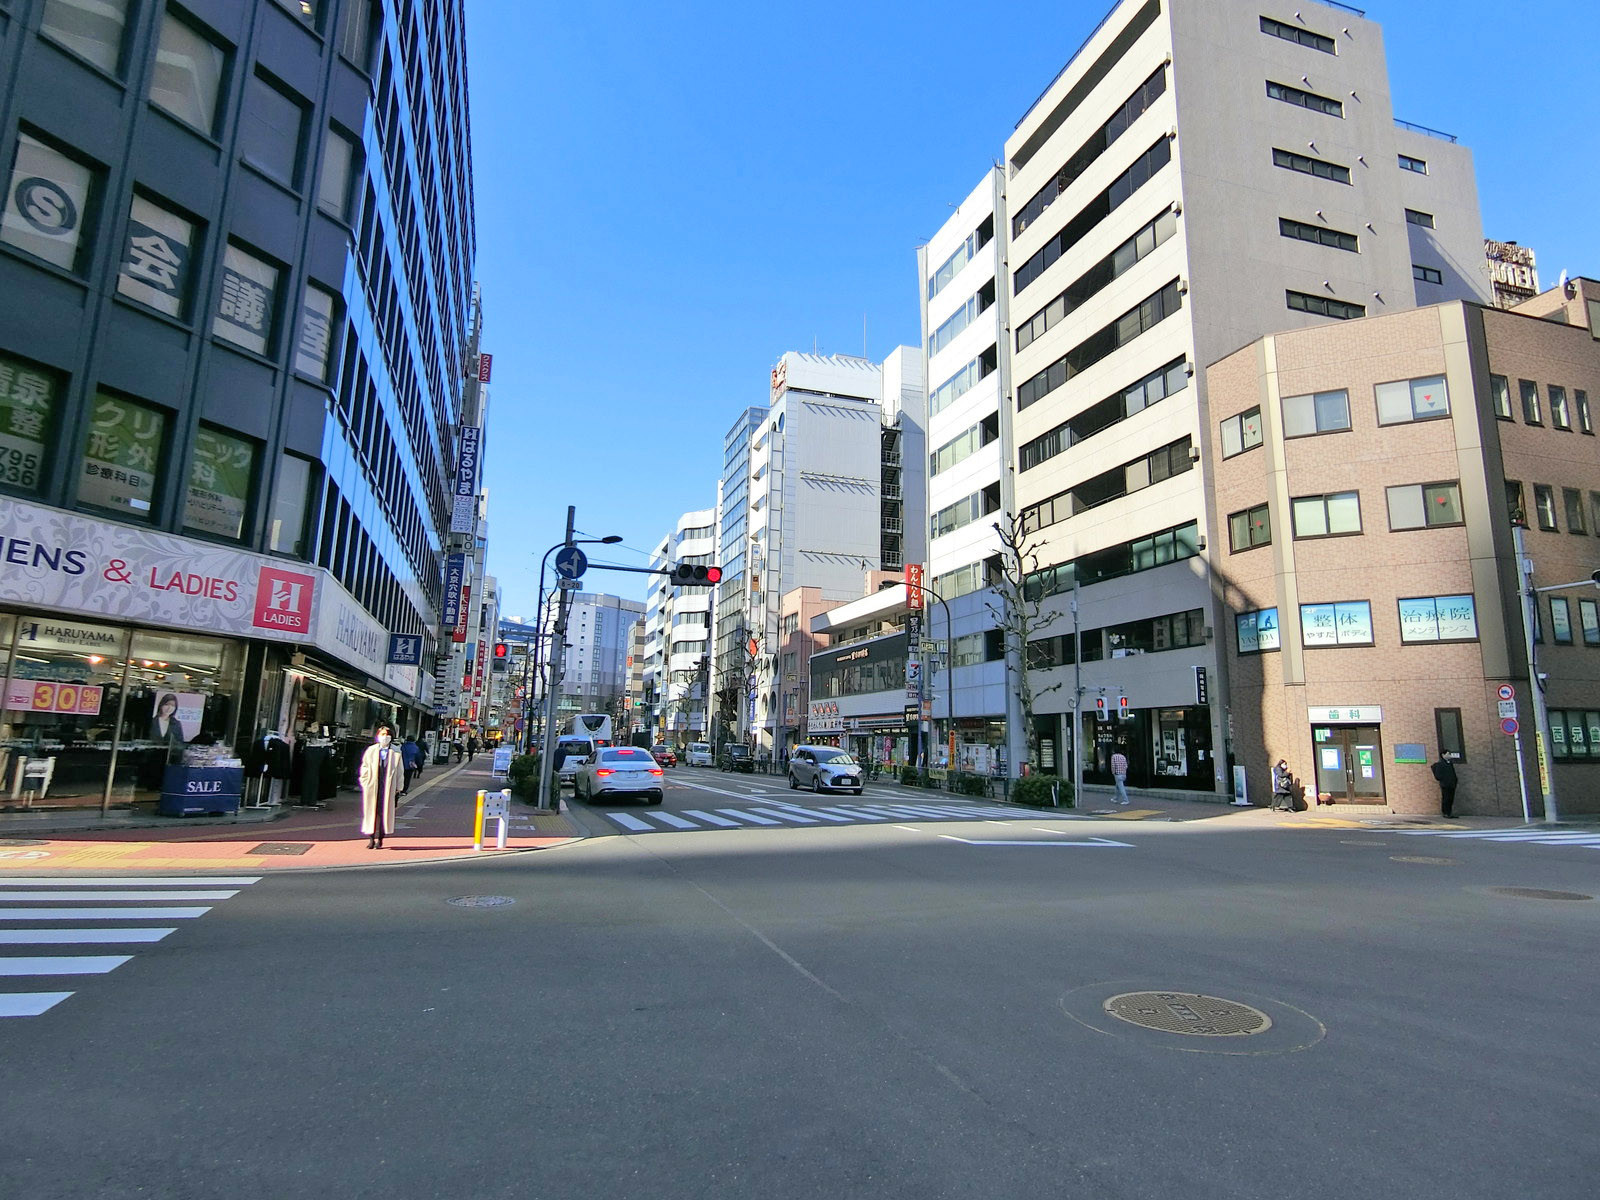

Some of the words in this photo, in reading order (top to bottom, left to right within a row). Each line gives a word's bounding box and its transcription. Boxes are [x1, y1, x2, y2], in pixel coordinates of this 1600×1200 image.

[86, 463, 140, 487] 診療科目
[460, 440, 476, 495] はるやま
[103, 558, 132, 584] &
[150, 567, 239, 601] LADIES
[445, 568, 460, 624] 大京穴吹不動産
[263, 612, 301, 627] LADIES
[1313, 612, 1358, 628] 整体
[1403, 607, 1471, 623] 治療院
[1240, 618, 1256, 629] 2F
[1407, 624, 1470, 635] メンテナンス
[44, 625, 115, 643] HARUYAMA
[33, 685, 77, 710] 30
[82, 689, 99, 702] %
[1328, 709, 1361, 720] 歯科
[186, 780, 222, 793] SALE
